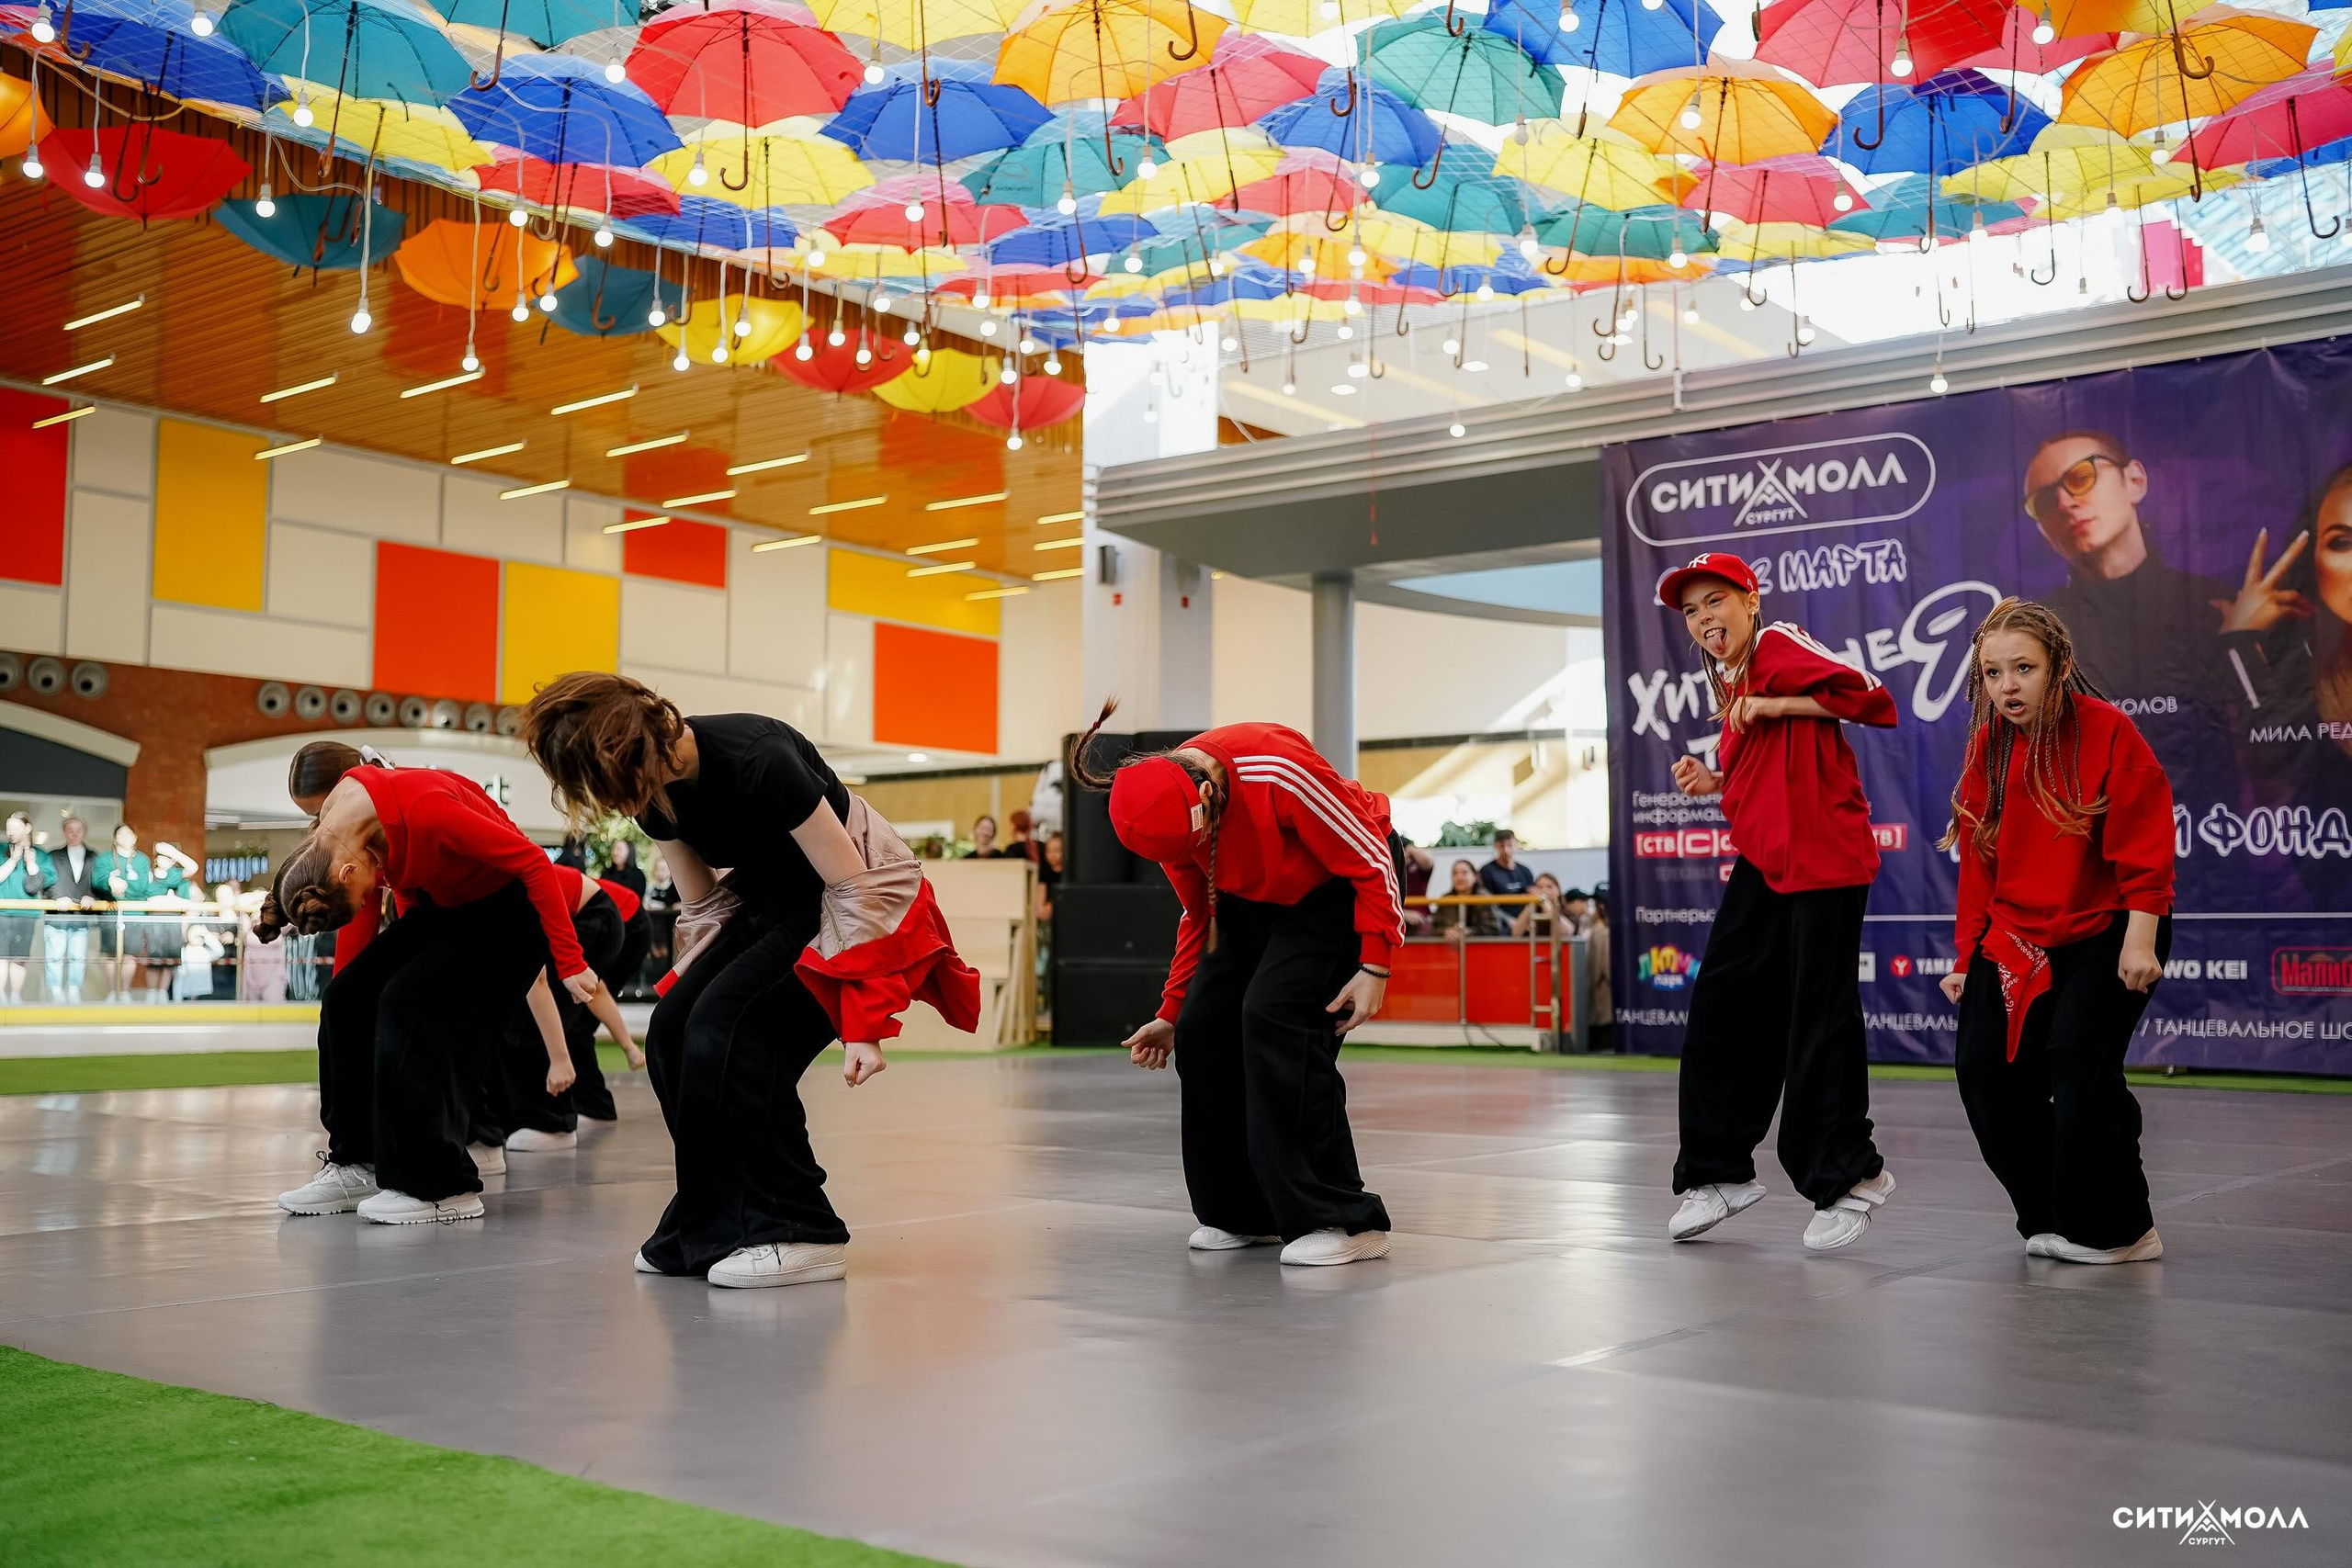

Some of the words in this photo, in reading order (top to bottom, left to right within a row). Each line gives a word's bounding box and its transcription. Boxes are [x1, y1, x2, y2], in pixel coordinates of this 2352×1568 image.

[1650, 470, 1755, 513] СИТИ
[1785, 452, 1908, 495] МОЛЛ
[1745, 507, 1796, 525] СУРГУТ
[1779, 538, 1907, 593] МАРТА
[2250, 725, 2312, 744] МИЛА
[2207, 960, 2248, 980] KEI
[2154, 1018, 2314, 1039] ТАНЦЕВАЛЬНОЕ
